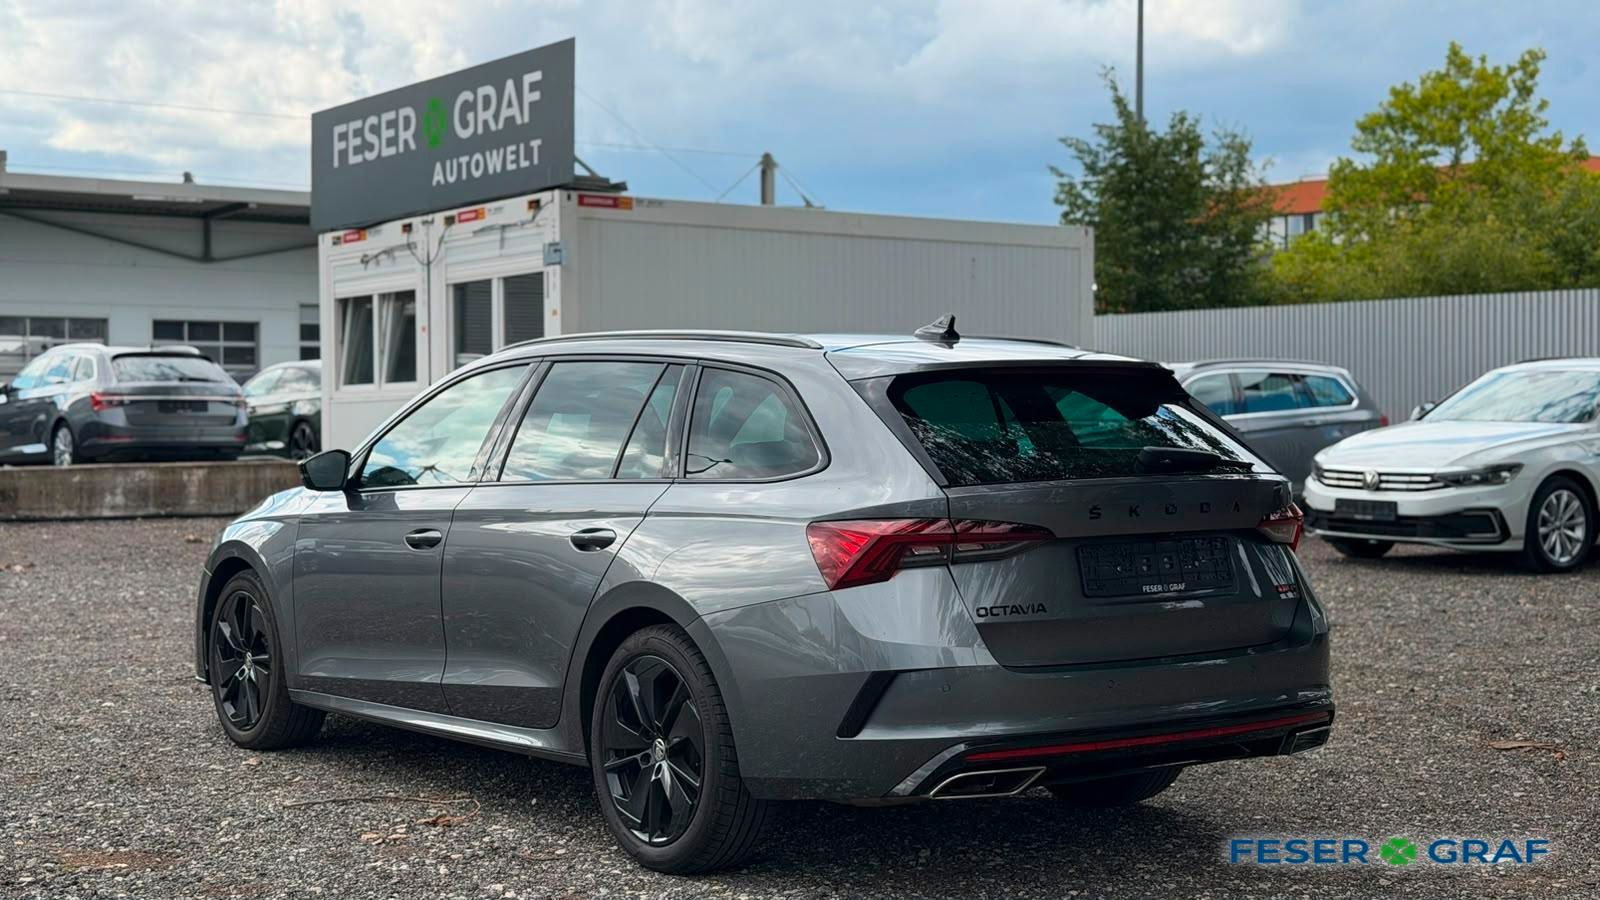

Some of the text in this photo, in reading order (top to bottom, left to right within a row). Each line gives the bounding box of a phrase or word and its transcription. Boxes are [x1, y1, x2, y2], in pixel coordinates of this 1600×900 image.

[332, 70, 543, 168] FESER GRAF
[432, 139, 542, 186] AUTOWELT
[1142, 582, 1186, 593] FESER GRAF
[975, 603, 1048, 618] OCTAVIA
